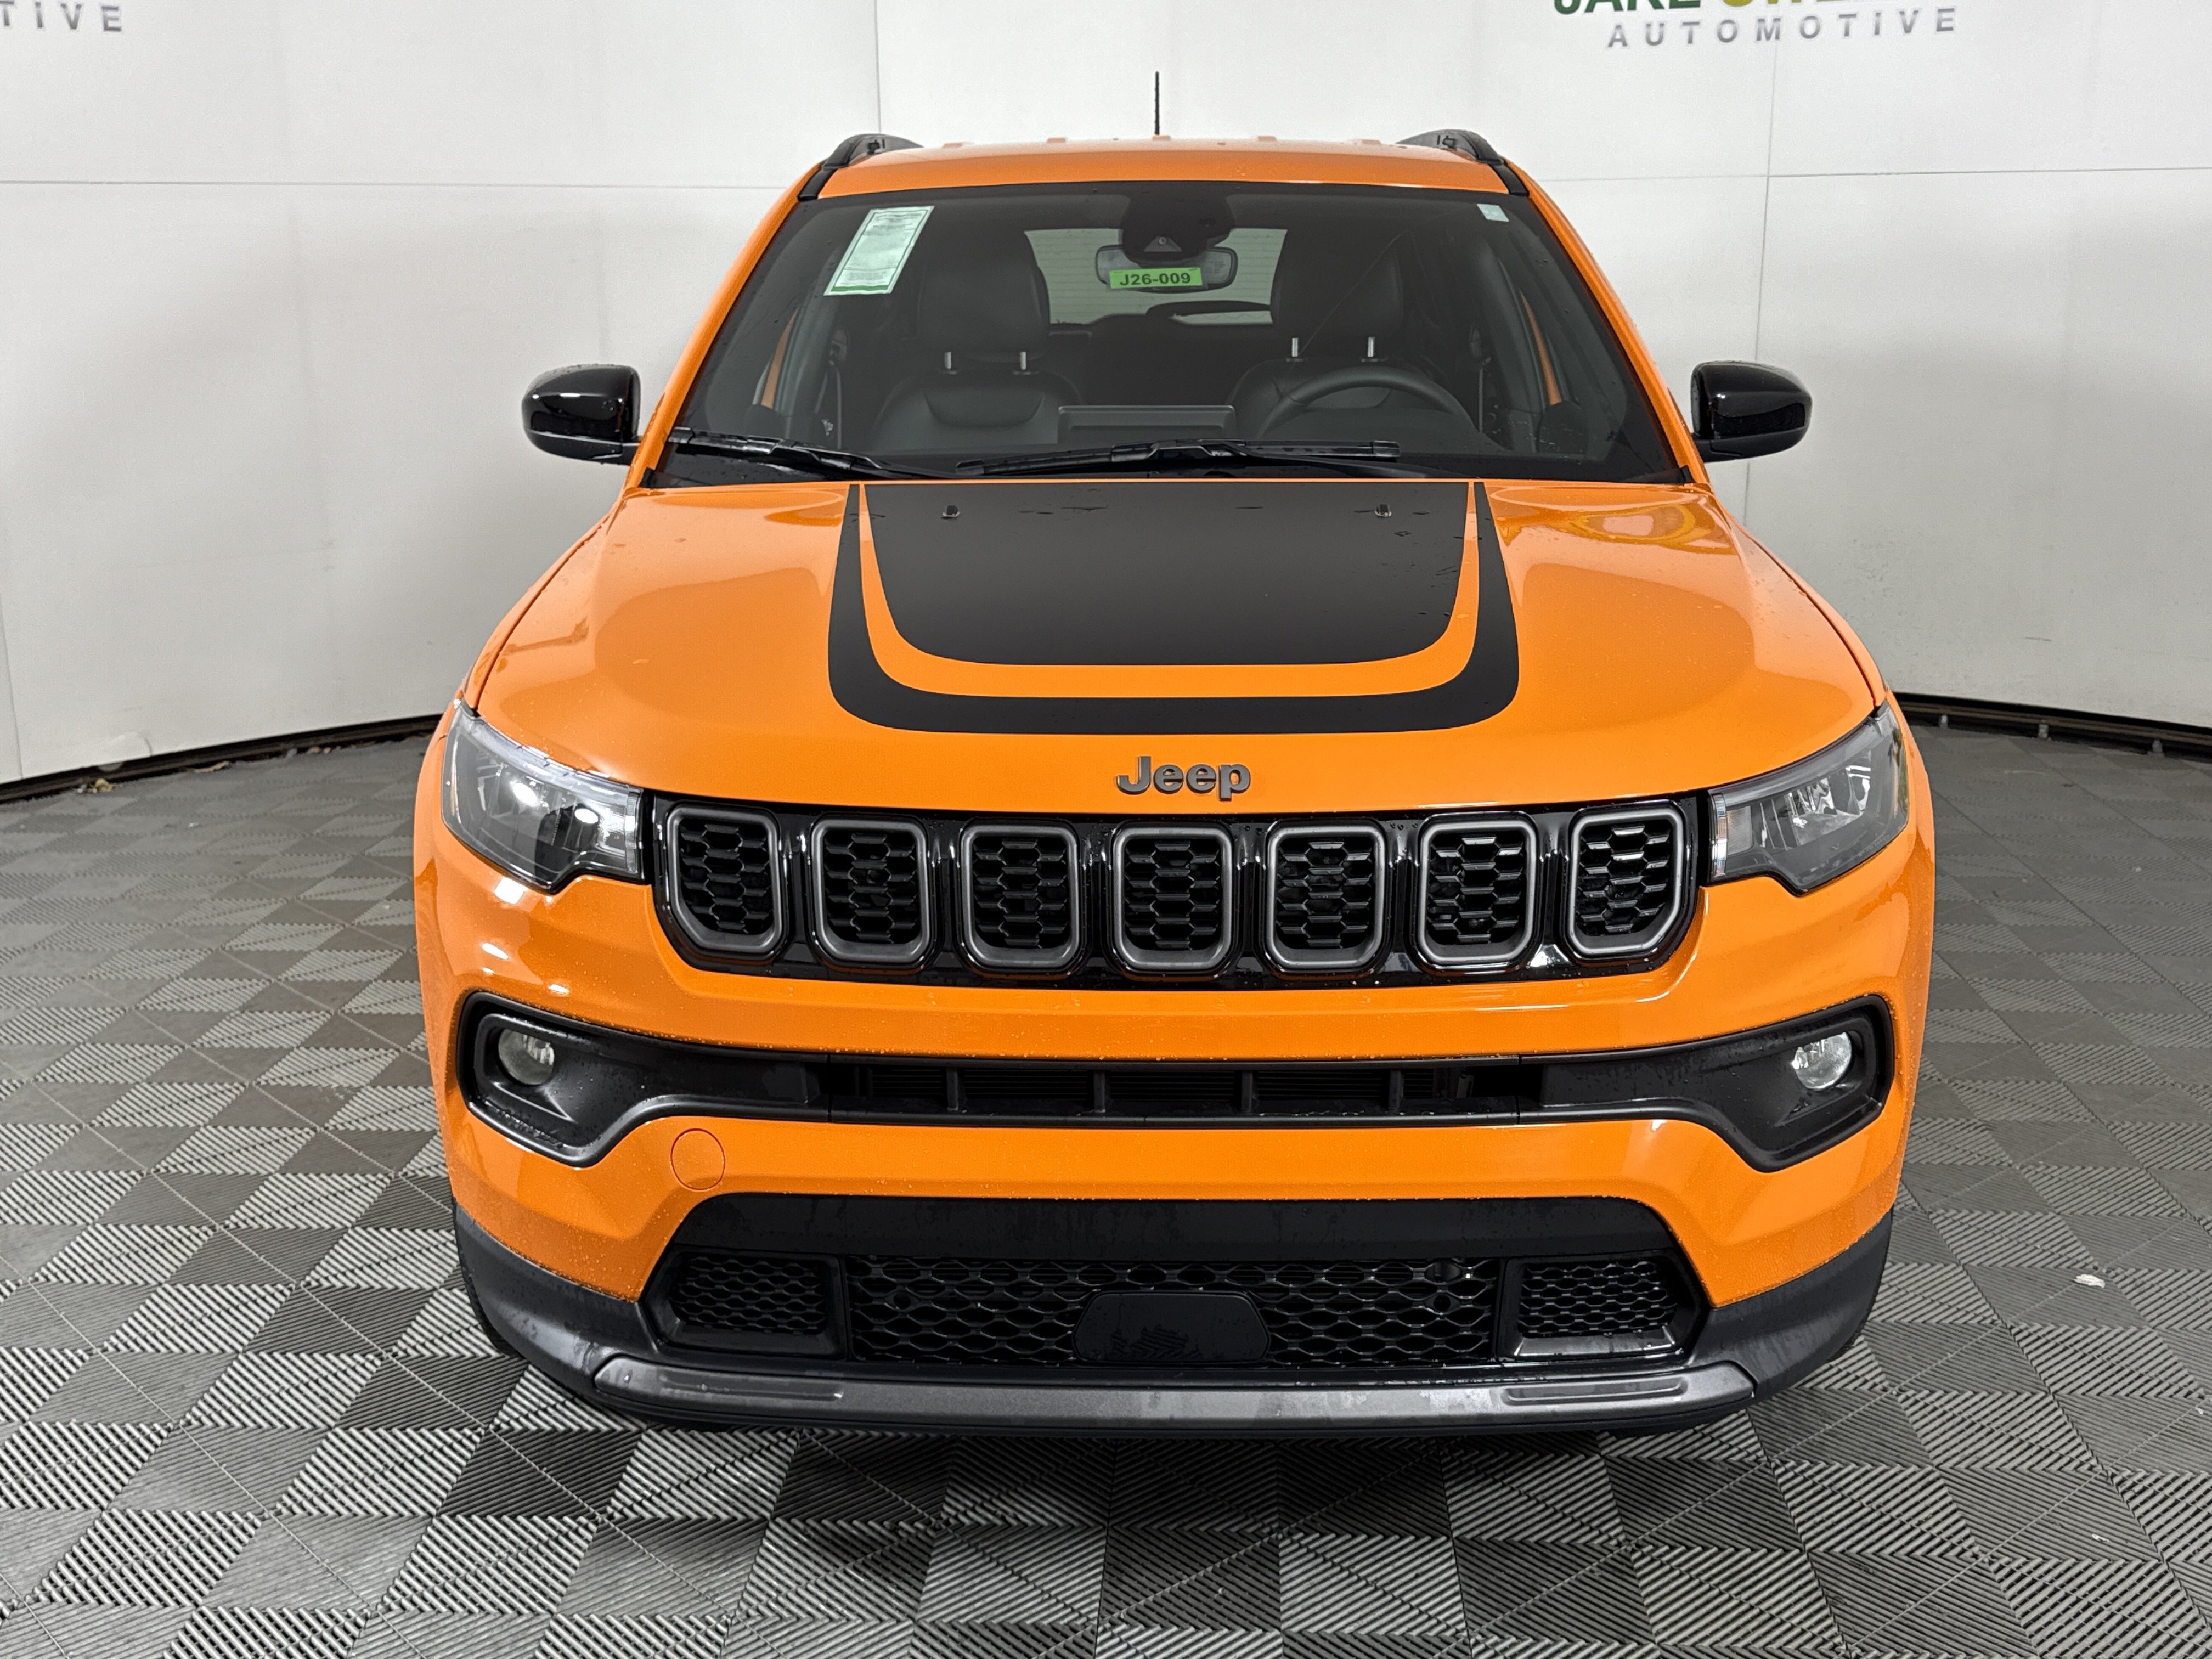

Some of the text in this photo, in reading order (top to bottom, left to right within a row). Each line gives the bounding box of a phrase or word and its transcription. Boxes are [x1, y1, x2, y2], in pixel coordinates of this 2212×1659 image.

[1607, 8, 1955, 47] AUTOMOTIVE
[1119, 272, 1191, 286] J26-009
[1116, 755, 1251, 801] Jeep
